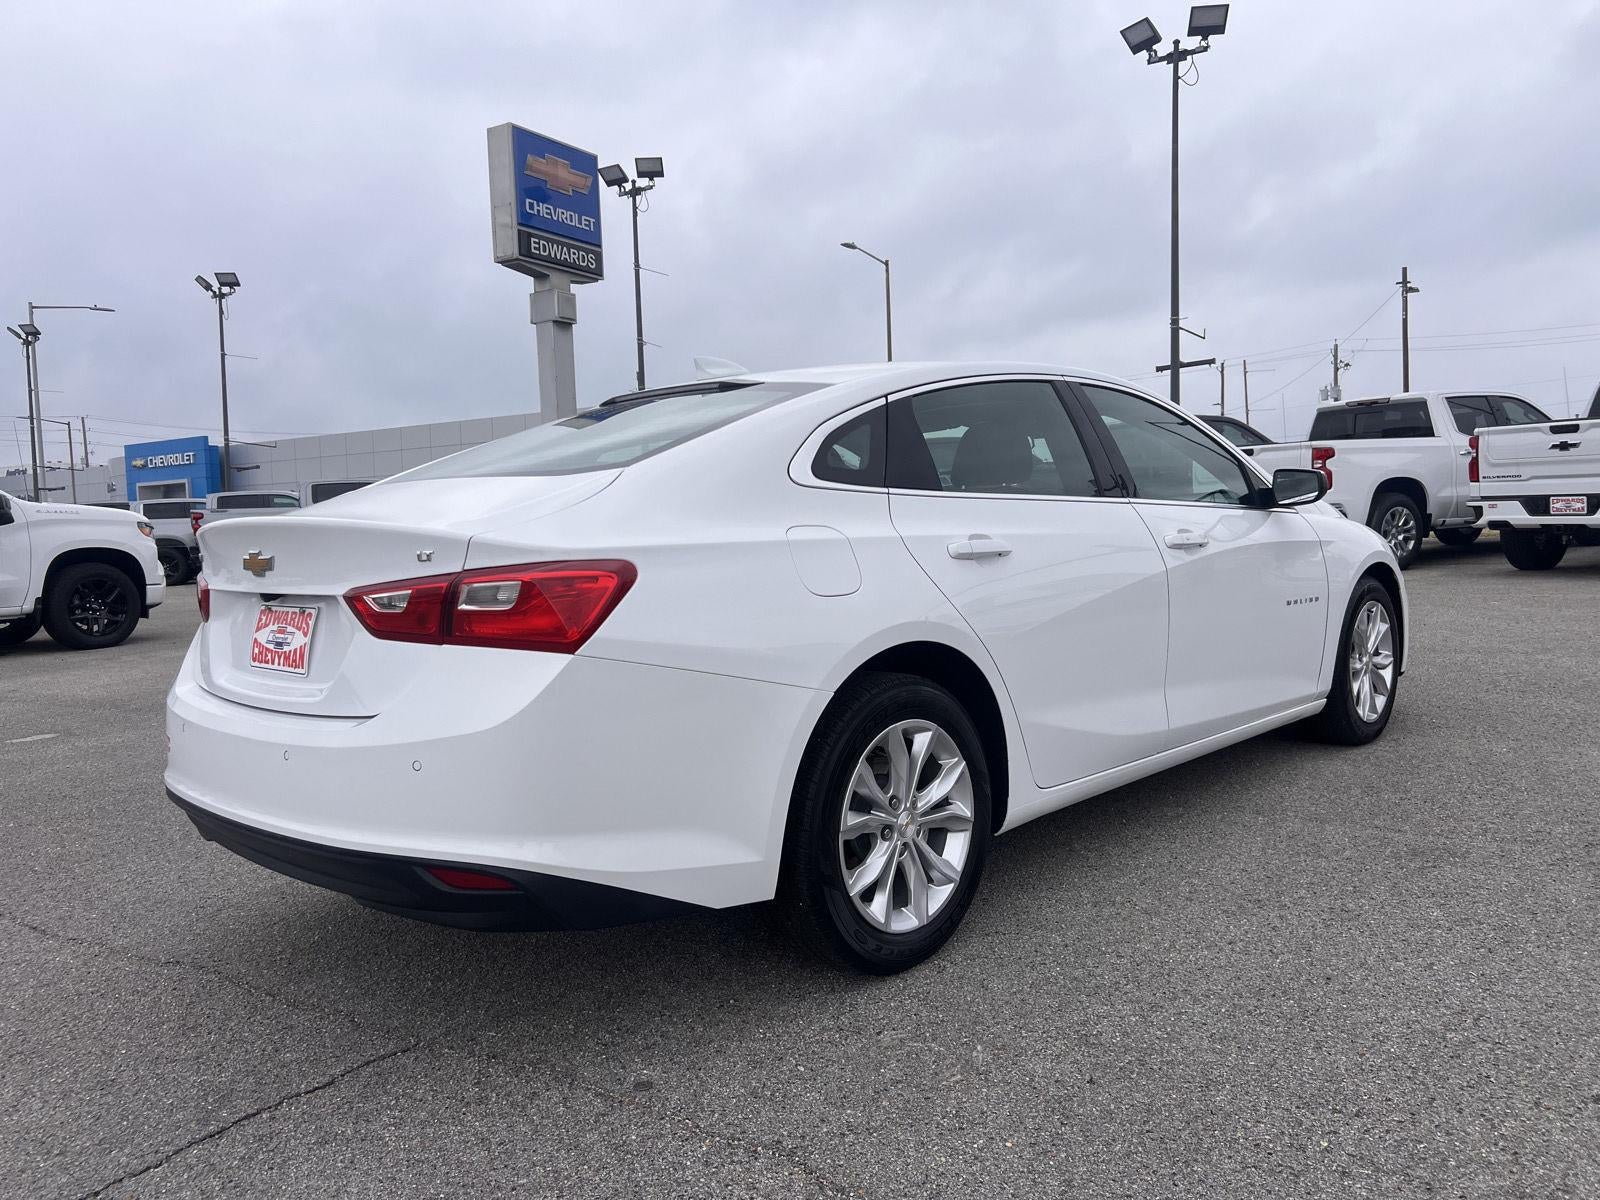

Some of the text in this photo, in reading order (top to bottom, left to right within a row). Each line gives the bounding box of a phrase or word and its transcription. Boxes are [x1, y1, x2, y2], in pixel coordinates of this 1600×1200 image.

[525, 198, 595, 231] CHEVROLET
[530, 237, 596, 269] EDWARDS
[147, 452, 195, 468] CHEVROLET
[416, 550, 434, 562] LT
[255, 608, 313, 638] EDWARDS
[251, 637, 307, 669] CHEVYMAN
